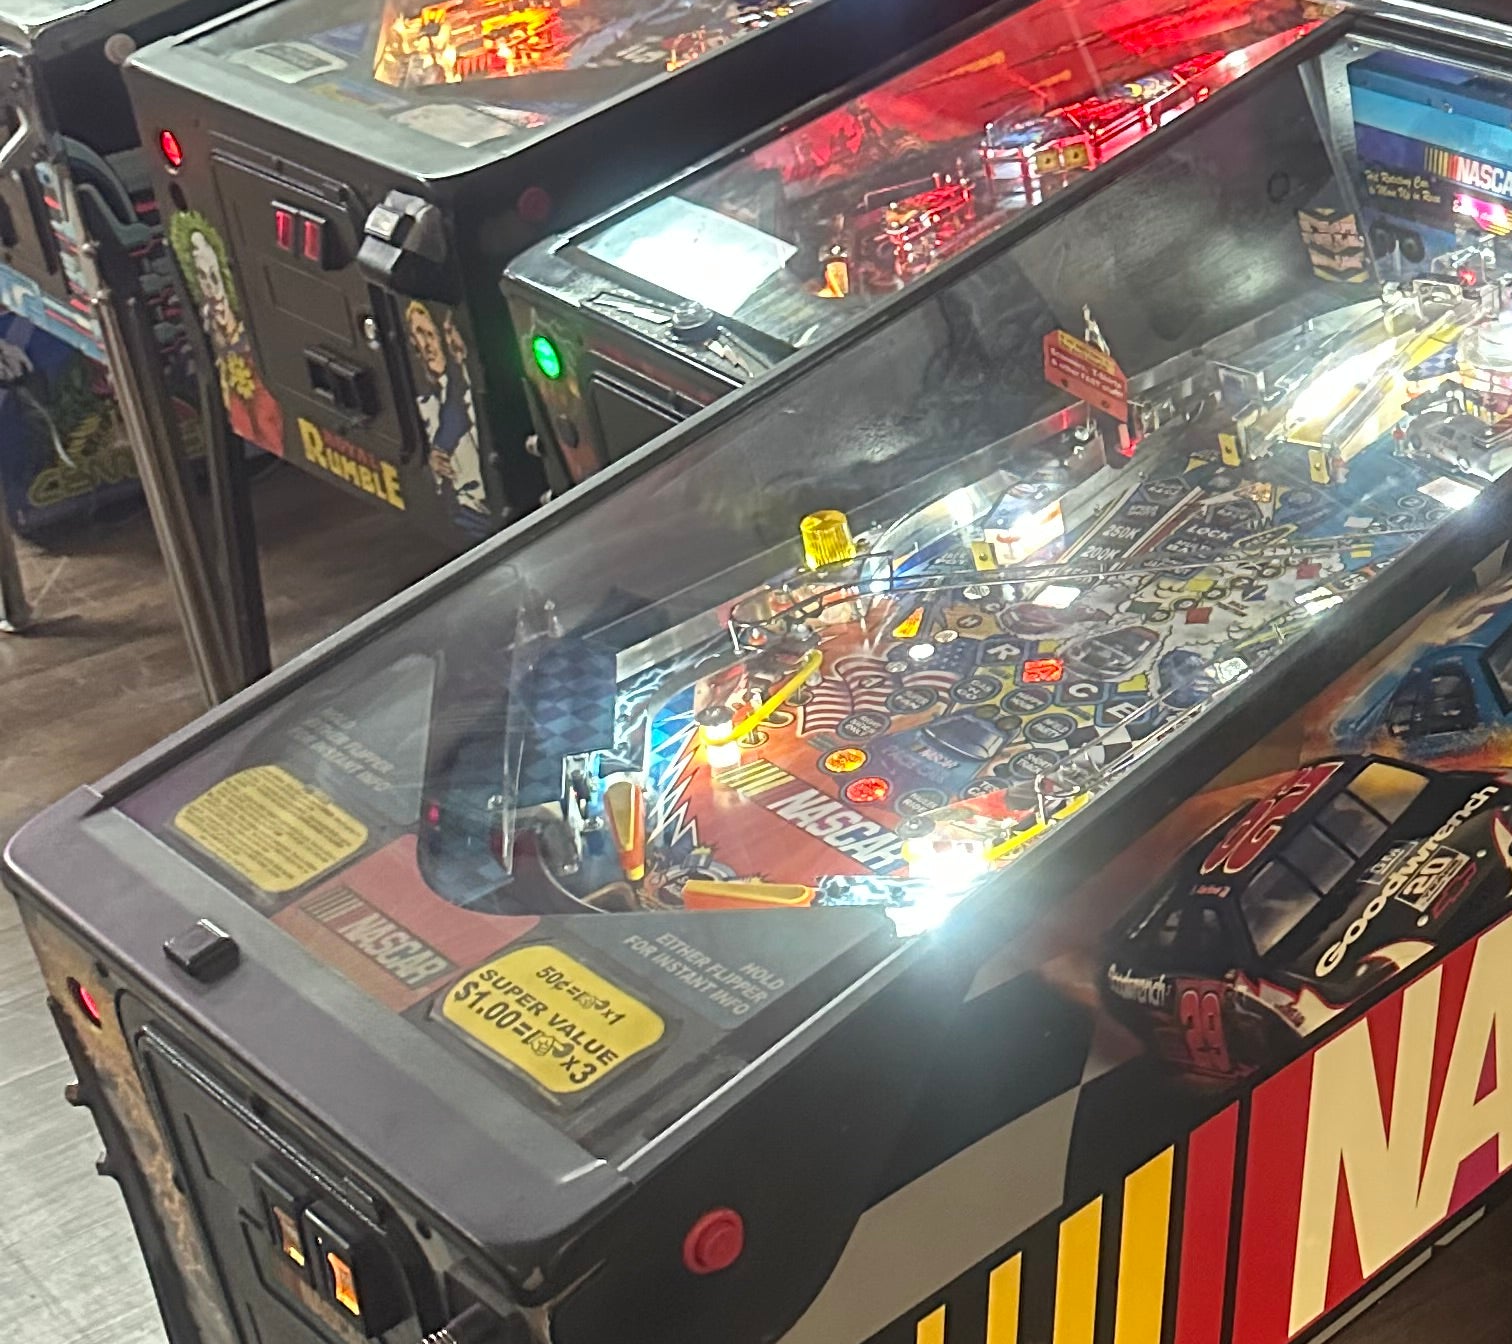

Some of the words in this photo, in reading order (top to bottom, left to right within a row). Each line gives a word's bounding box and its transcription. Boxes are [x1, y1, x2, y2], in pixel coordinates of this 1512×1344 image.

[297, 416, 406, 512] RUMBLE
[1079, 544, 1122, 561] 200K
[1102, 523, 1142, 541] 250K
[1187, 524, 1236, 542] LOCK
[1067, 682, 1099, 699] C
[766, 787, 907, 872] NASCAR
[1314, 784, 1500, 978] Goodwrench
[1402, 856, 1451, 898] 20
[339, 908, 449, 990] NASCAR
[622, 933, 658, 959] FOR
[650, 951, 714, 995] INSTANT
[708, 986, 750, 1018] INFO
[654, 930, 708, 969] EITHER
[705, 961, 771, 1006] FLIPPER
[738, 961, 786, 993] HOLD
[478, 968, 549, 1018] SUPER
[547, 1012, 620, 1067] VALUE
